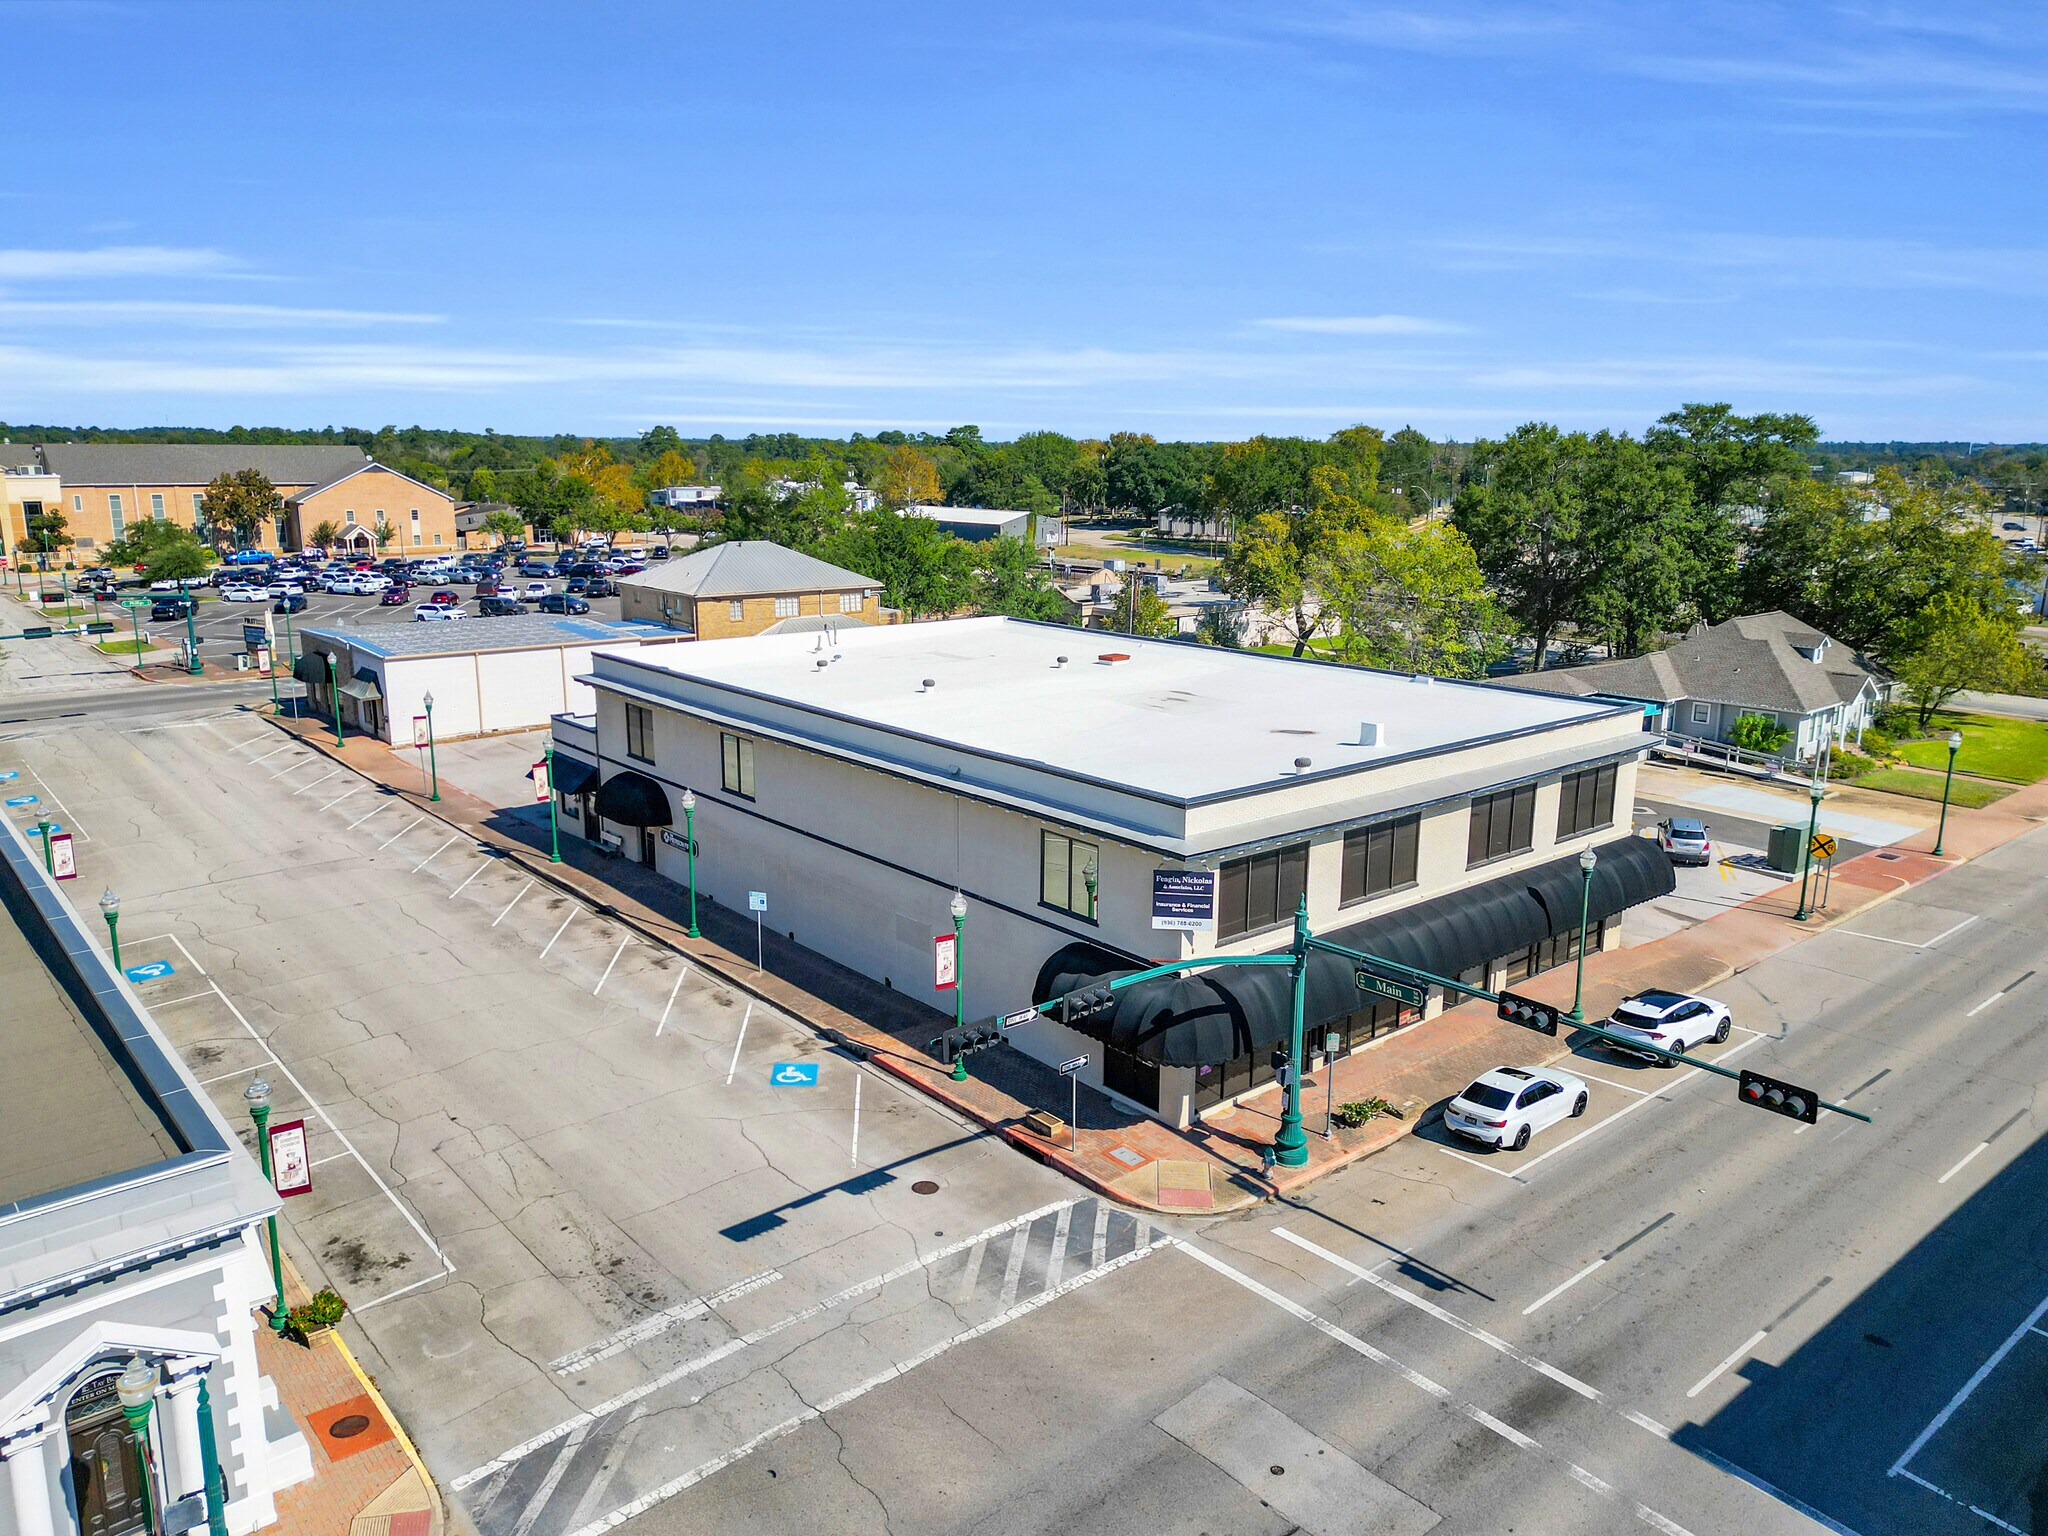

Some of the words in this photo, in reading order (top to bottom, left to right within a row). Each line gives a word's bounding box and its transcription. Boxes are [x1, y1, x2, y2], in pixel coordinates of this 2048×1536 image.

[1182, 876, 1213, 884] Nickolas
[1376, 980, 1403, 998] Main
[71, 1391, 95, 1404] ENTER
[95, 1386, 107, 1396] ON
